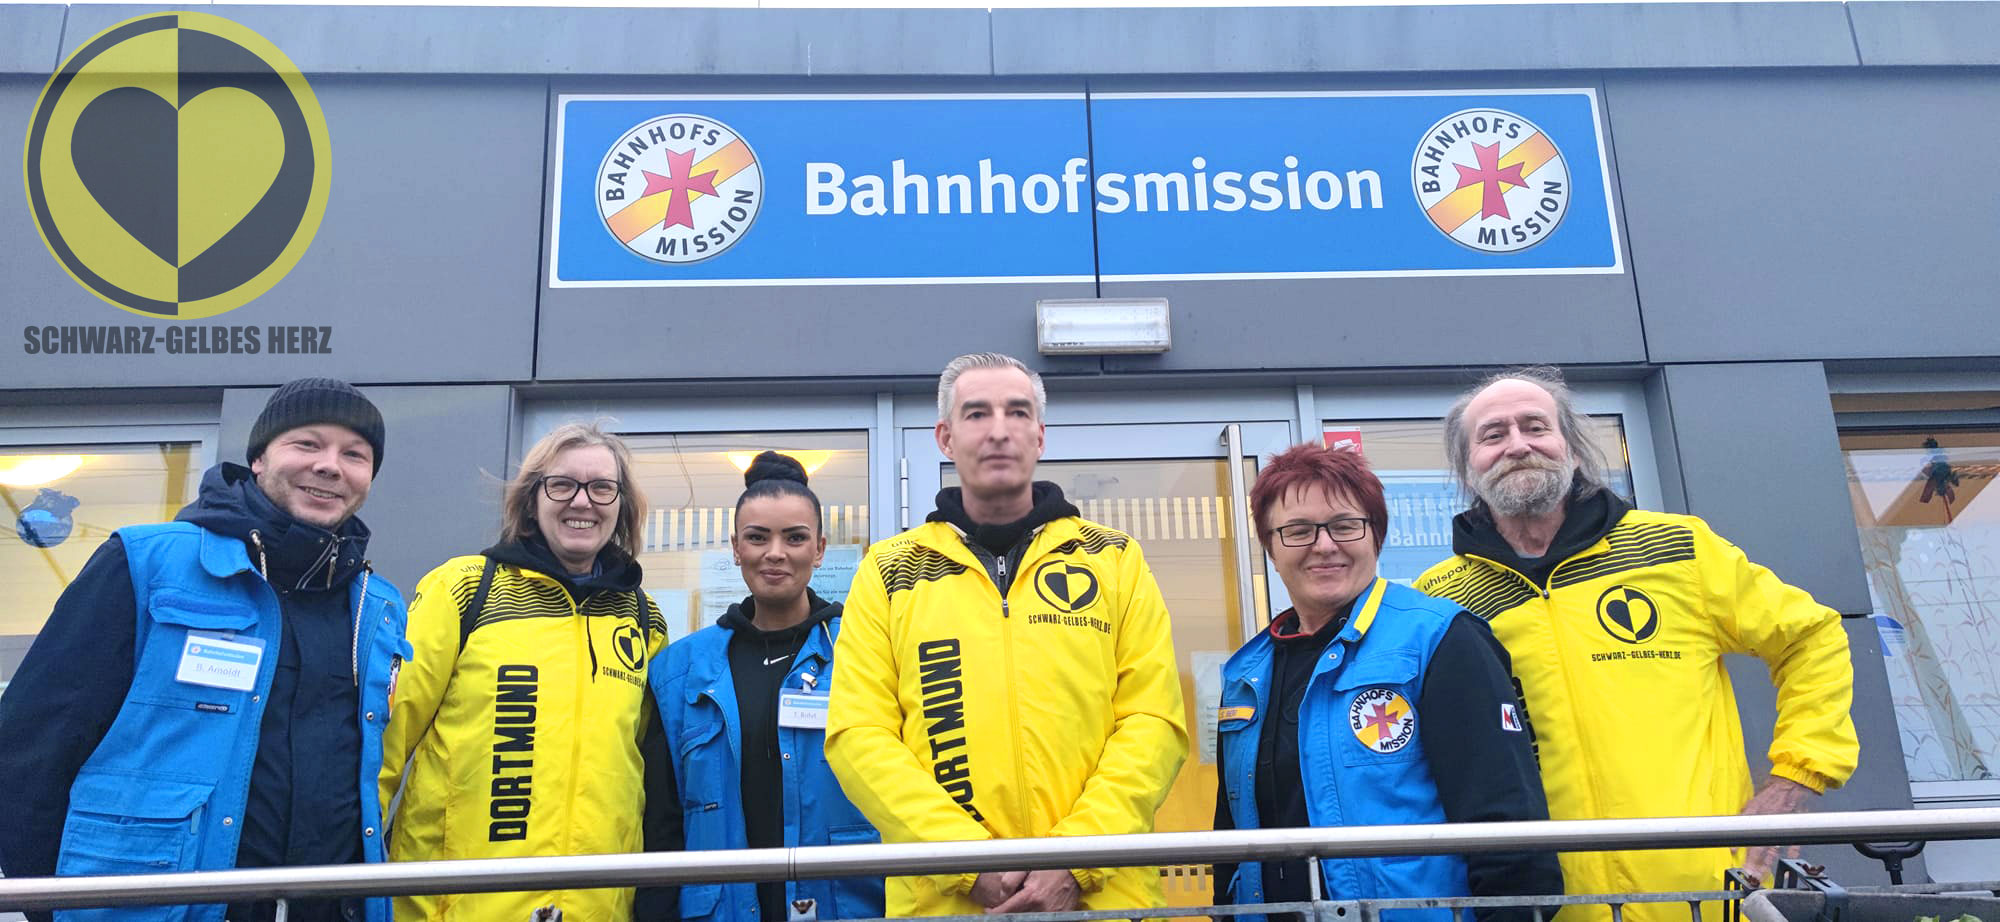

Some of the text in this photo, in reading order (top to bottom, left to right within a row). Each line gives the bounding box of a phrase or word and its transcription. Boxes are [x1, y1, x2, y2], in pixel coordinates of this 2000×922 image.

[605, 122, 721, 202] BAHNHOFS
[806, 154, 1384, 216] Bahnhofsmission
[1422, 115, 1522, 194] BAHNHOFS
[655, 187, 755, 257] MISSION
[1477, 179, 1563, 246] MISSION
[1423, 560, 1472, 591] uhlsport
[1351, 690, 1393, 730] BAHNHOFS
[1380, 718, 1414, 751] MISSION
[489, 664, 538, 842] DORTMUND
